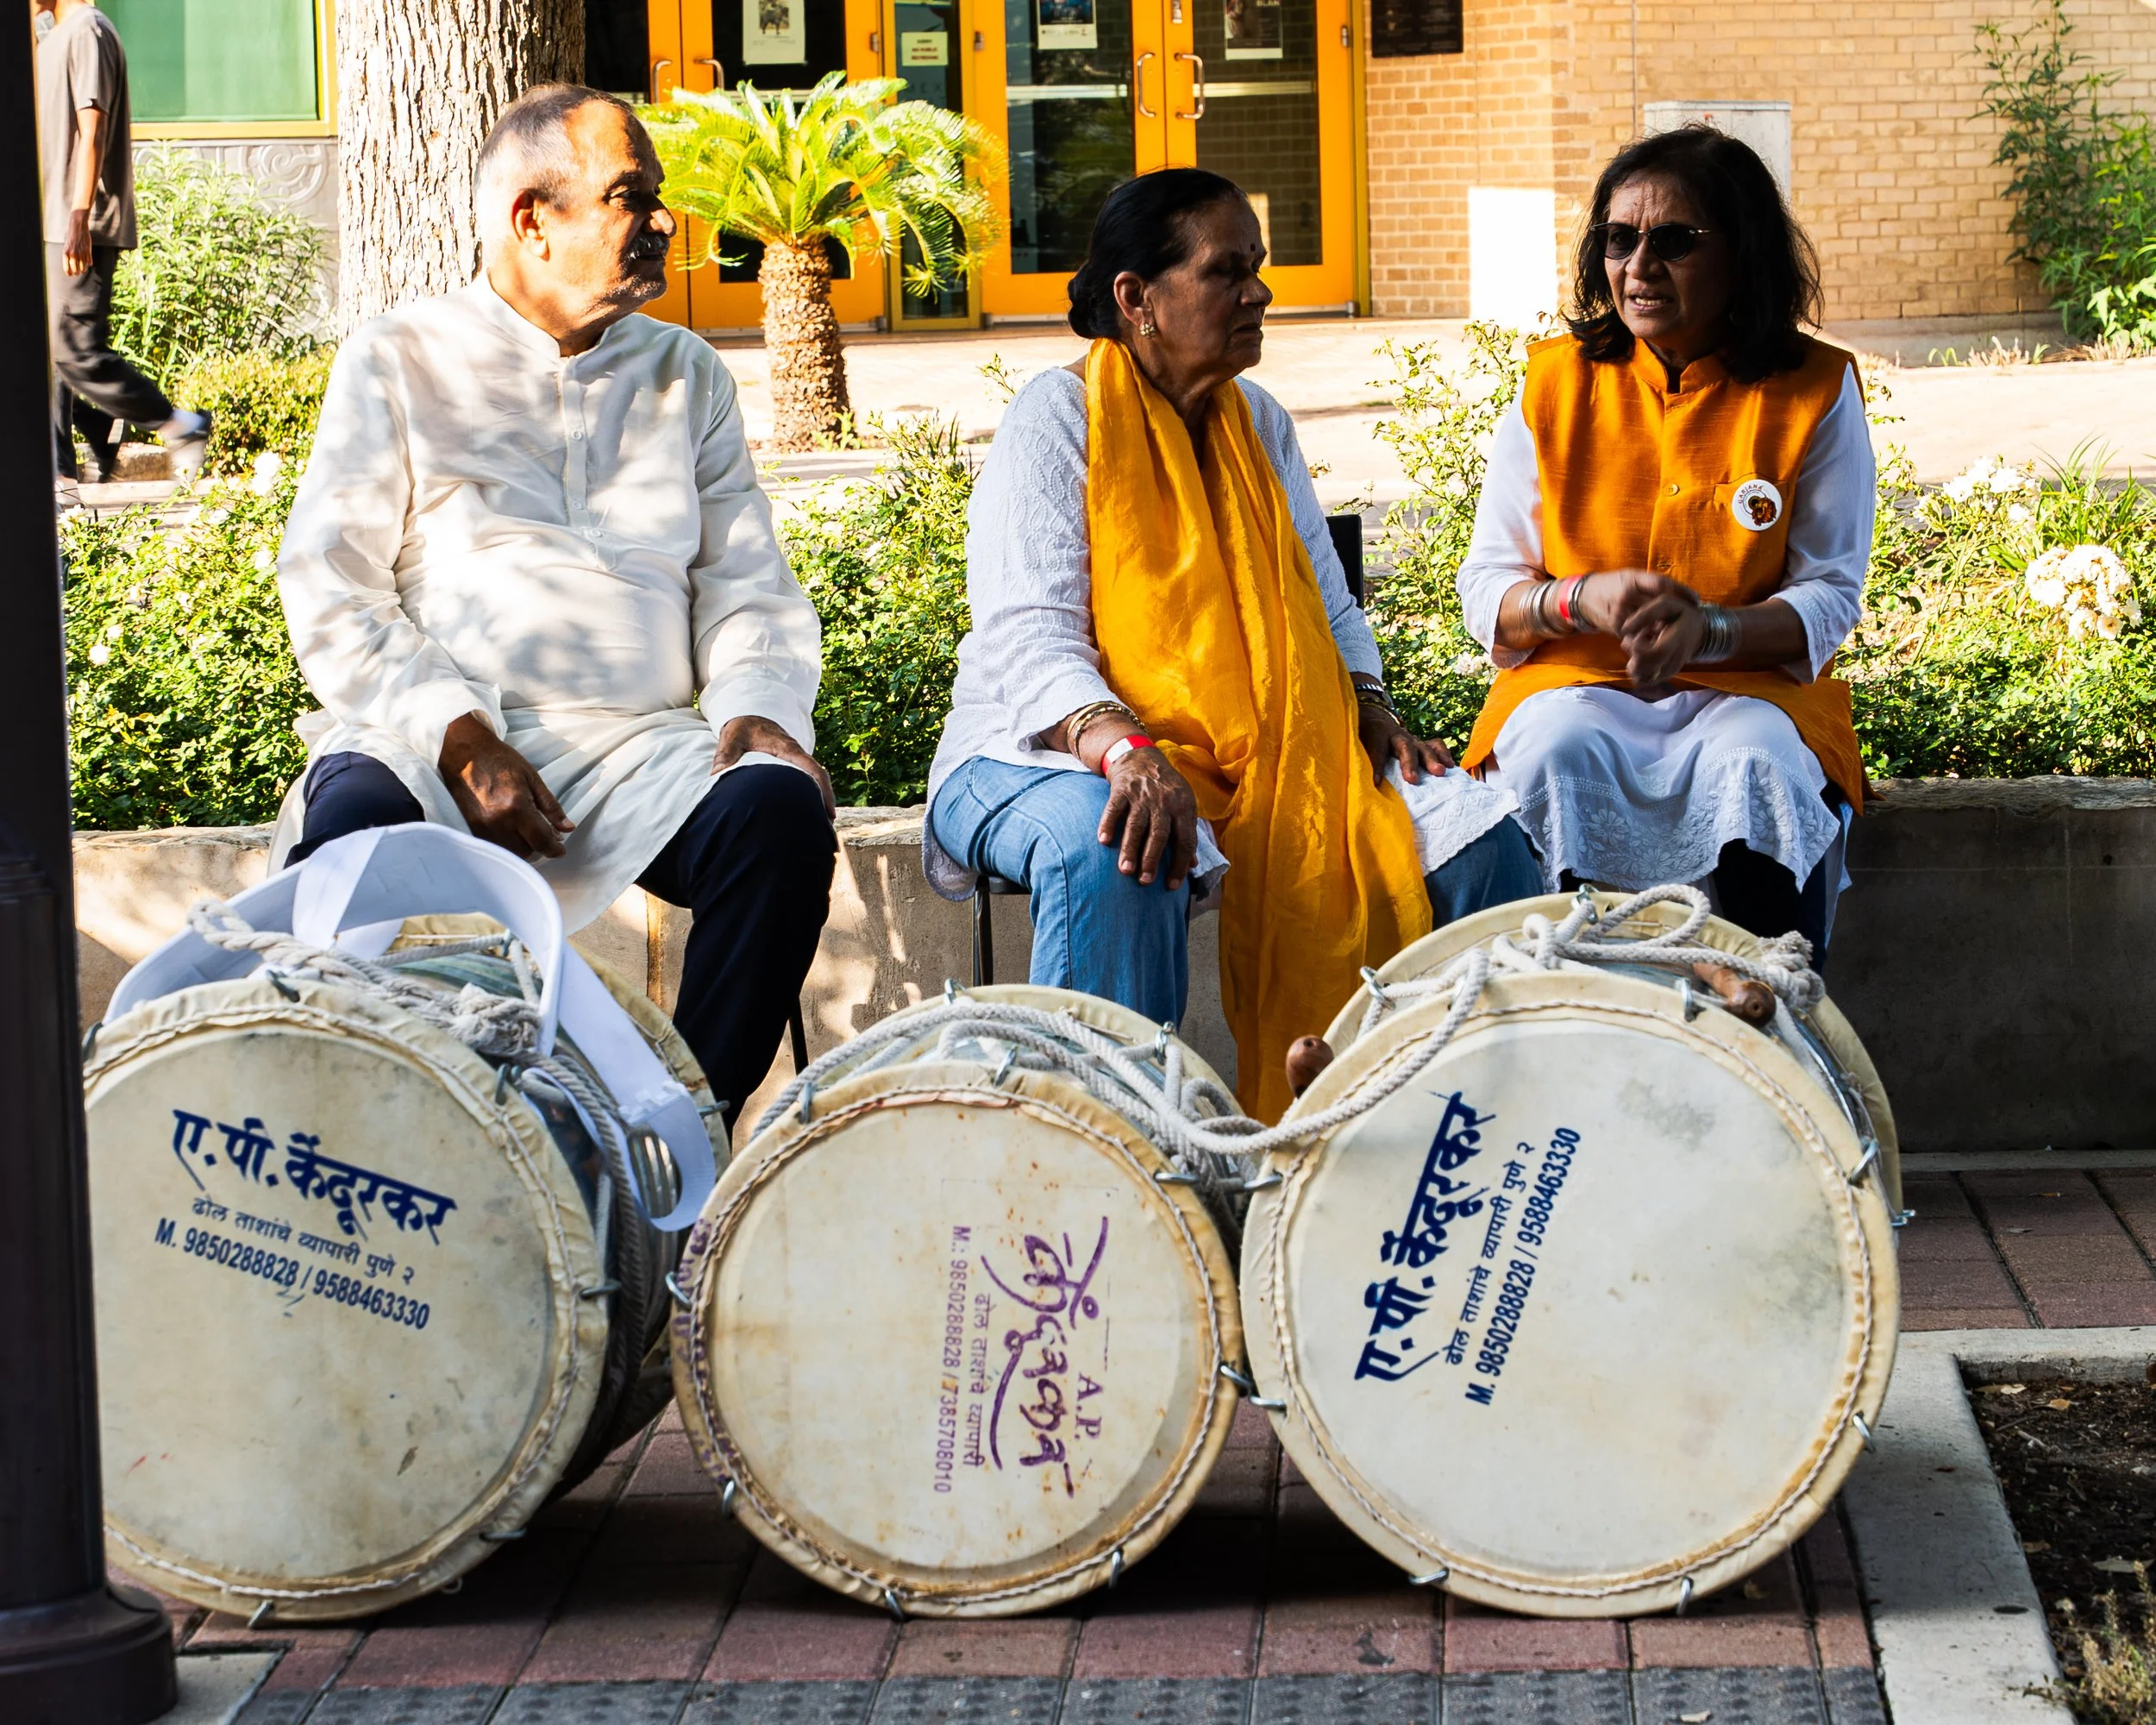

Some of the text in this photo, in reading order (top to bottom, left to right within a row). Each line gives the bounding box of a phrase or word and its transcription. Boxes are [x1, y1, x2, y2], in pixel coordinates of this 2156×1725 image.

[191, 1194, 229, 1221] ढोल
[235, 1211, 292, 1243] ताशांचे
[298, 1232, 360, 1264] व्यापारी
[367, 1254, 397, 1277] पुणे
[1518, 1127, 1581, 1245] 9588463330
[154, 1217, 176, 1247] M.
[183, 1227, 299, 1288] 9850288828
[313, 1270, 429, 1329] 9588463330
[943, 1259, 968, 1368] 9850288828
[1442, 1327, 1470, 1364] ढोल
[1461, 1265, 1492, 1322] ताशांचे
[1482, 1195, 1513, 1259] व्यापारी
[1503, 1160, 1527, 1193] पुणे
[1476, 1260, 1535, 1377] 9850288828
[962, 1404, 986, 1467] व्यापारी
[1465, 1383, 1496, 1405] M.
